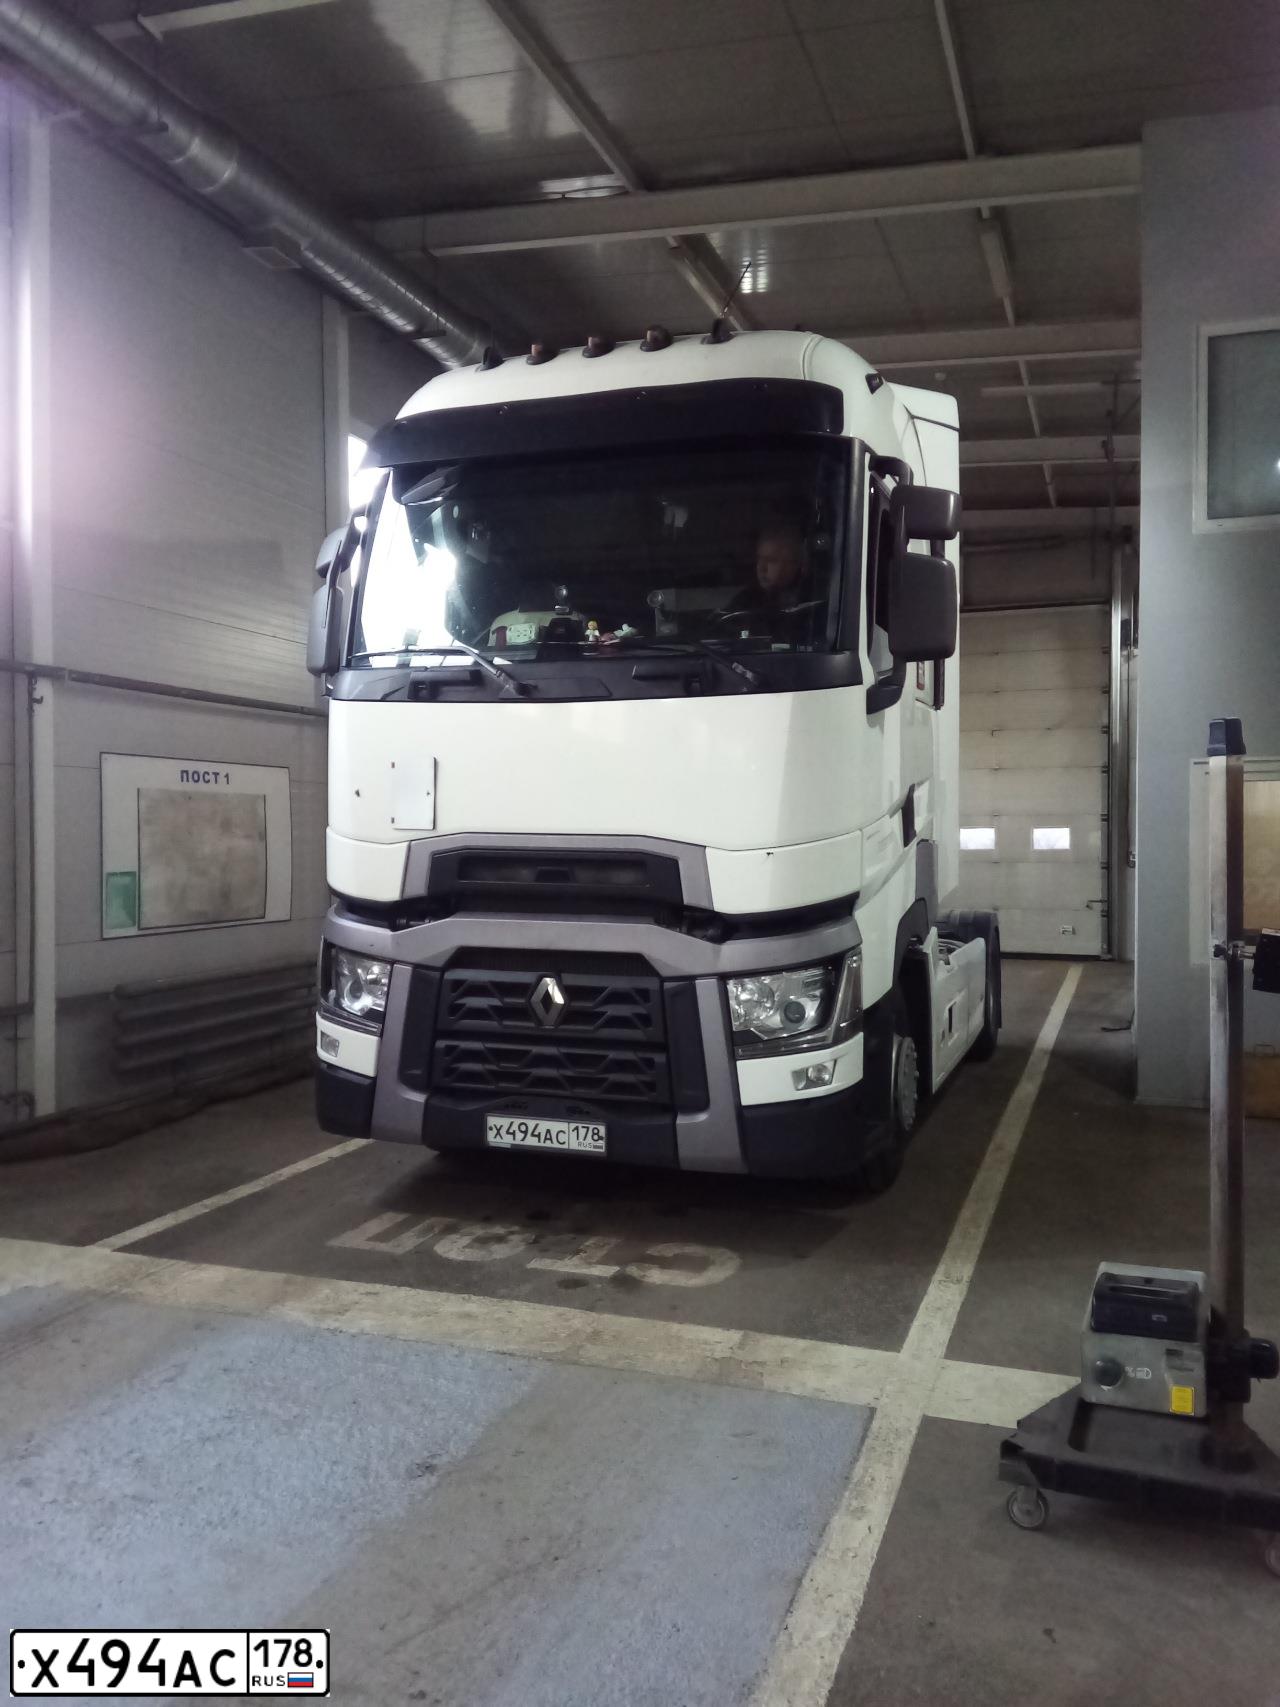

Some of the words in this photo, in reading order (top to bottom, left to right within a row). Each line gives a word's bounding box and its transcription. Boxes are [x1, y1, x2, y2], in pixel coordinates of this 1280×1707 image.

[180, 769, 220, 784] ПОСТ
[224, 773, 230, 785] 1
[493, 1121, 566, 1145] Х494АС
[571, 1125, 600, 1142] 178
[325, 1211, 743, 1288] СТОП
